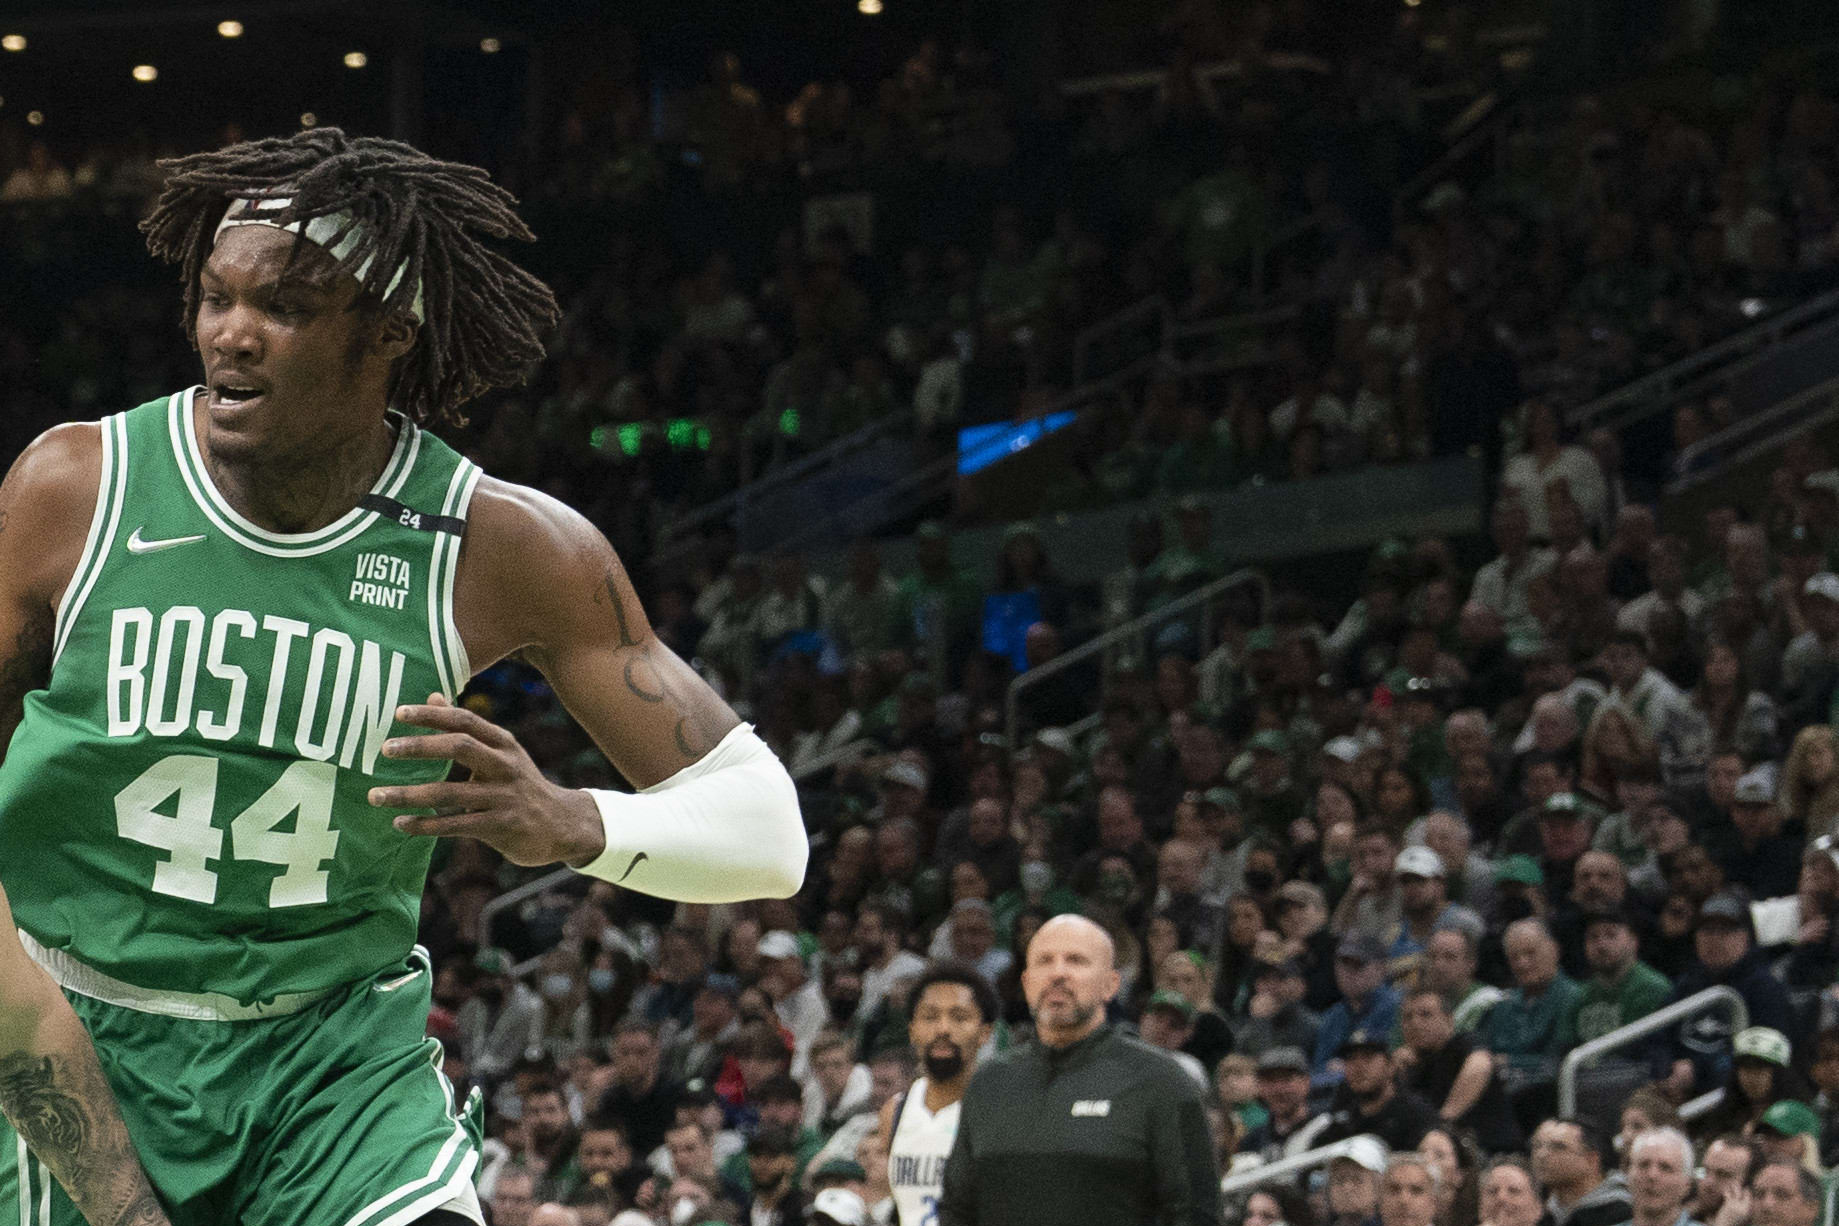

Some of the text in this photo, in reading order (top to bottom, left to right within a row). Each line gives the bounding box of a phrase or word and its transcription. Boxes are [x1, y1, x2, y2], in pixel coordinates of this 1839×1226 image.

[399, 508, 421, 529] 24
[355, 553, 410, 589] VISTA
[349, 580, 409, 610] PRINT
[107, 605, 406, 776] BOSTON
[113, 754, 340, 909] 44
